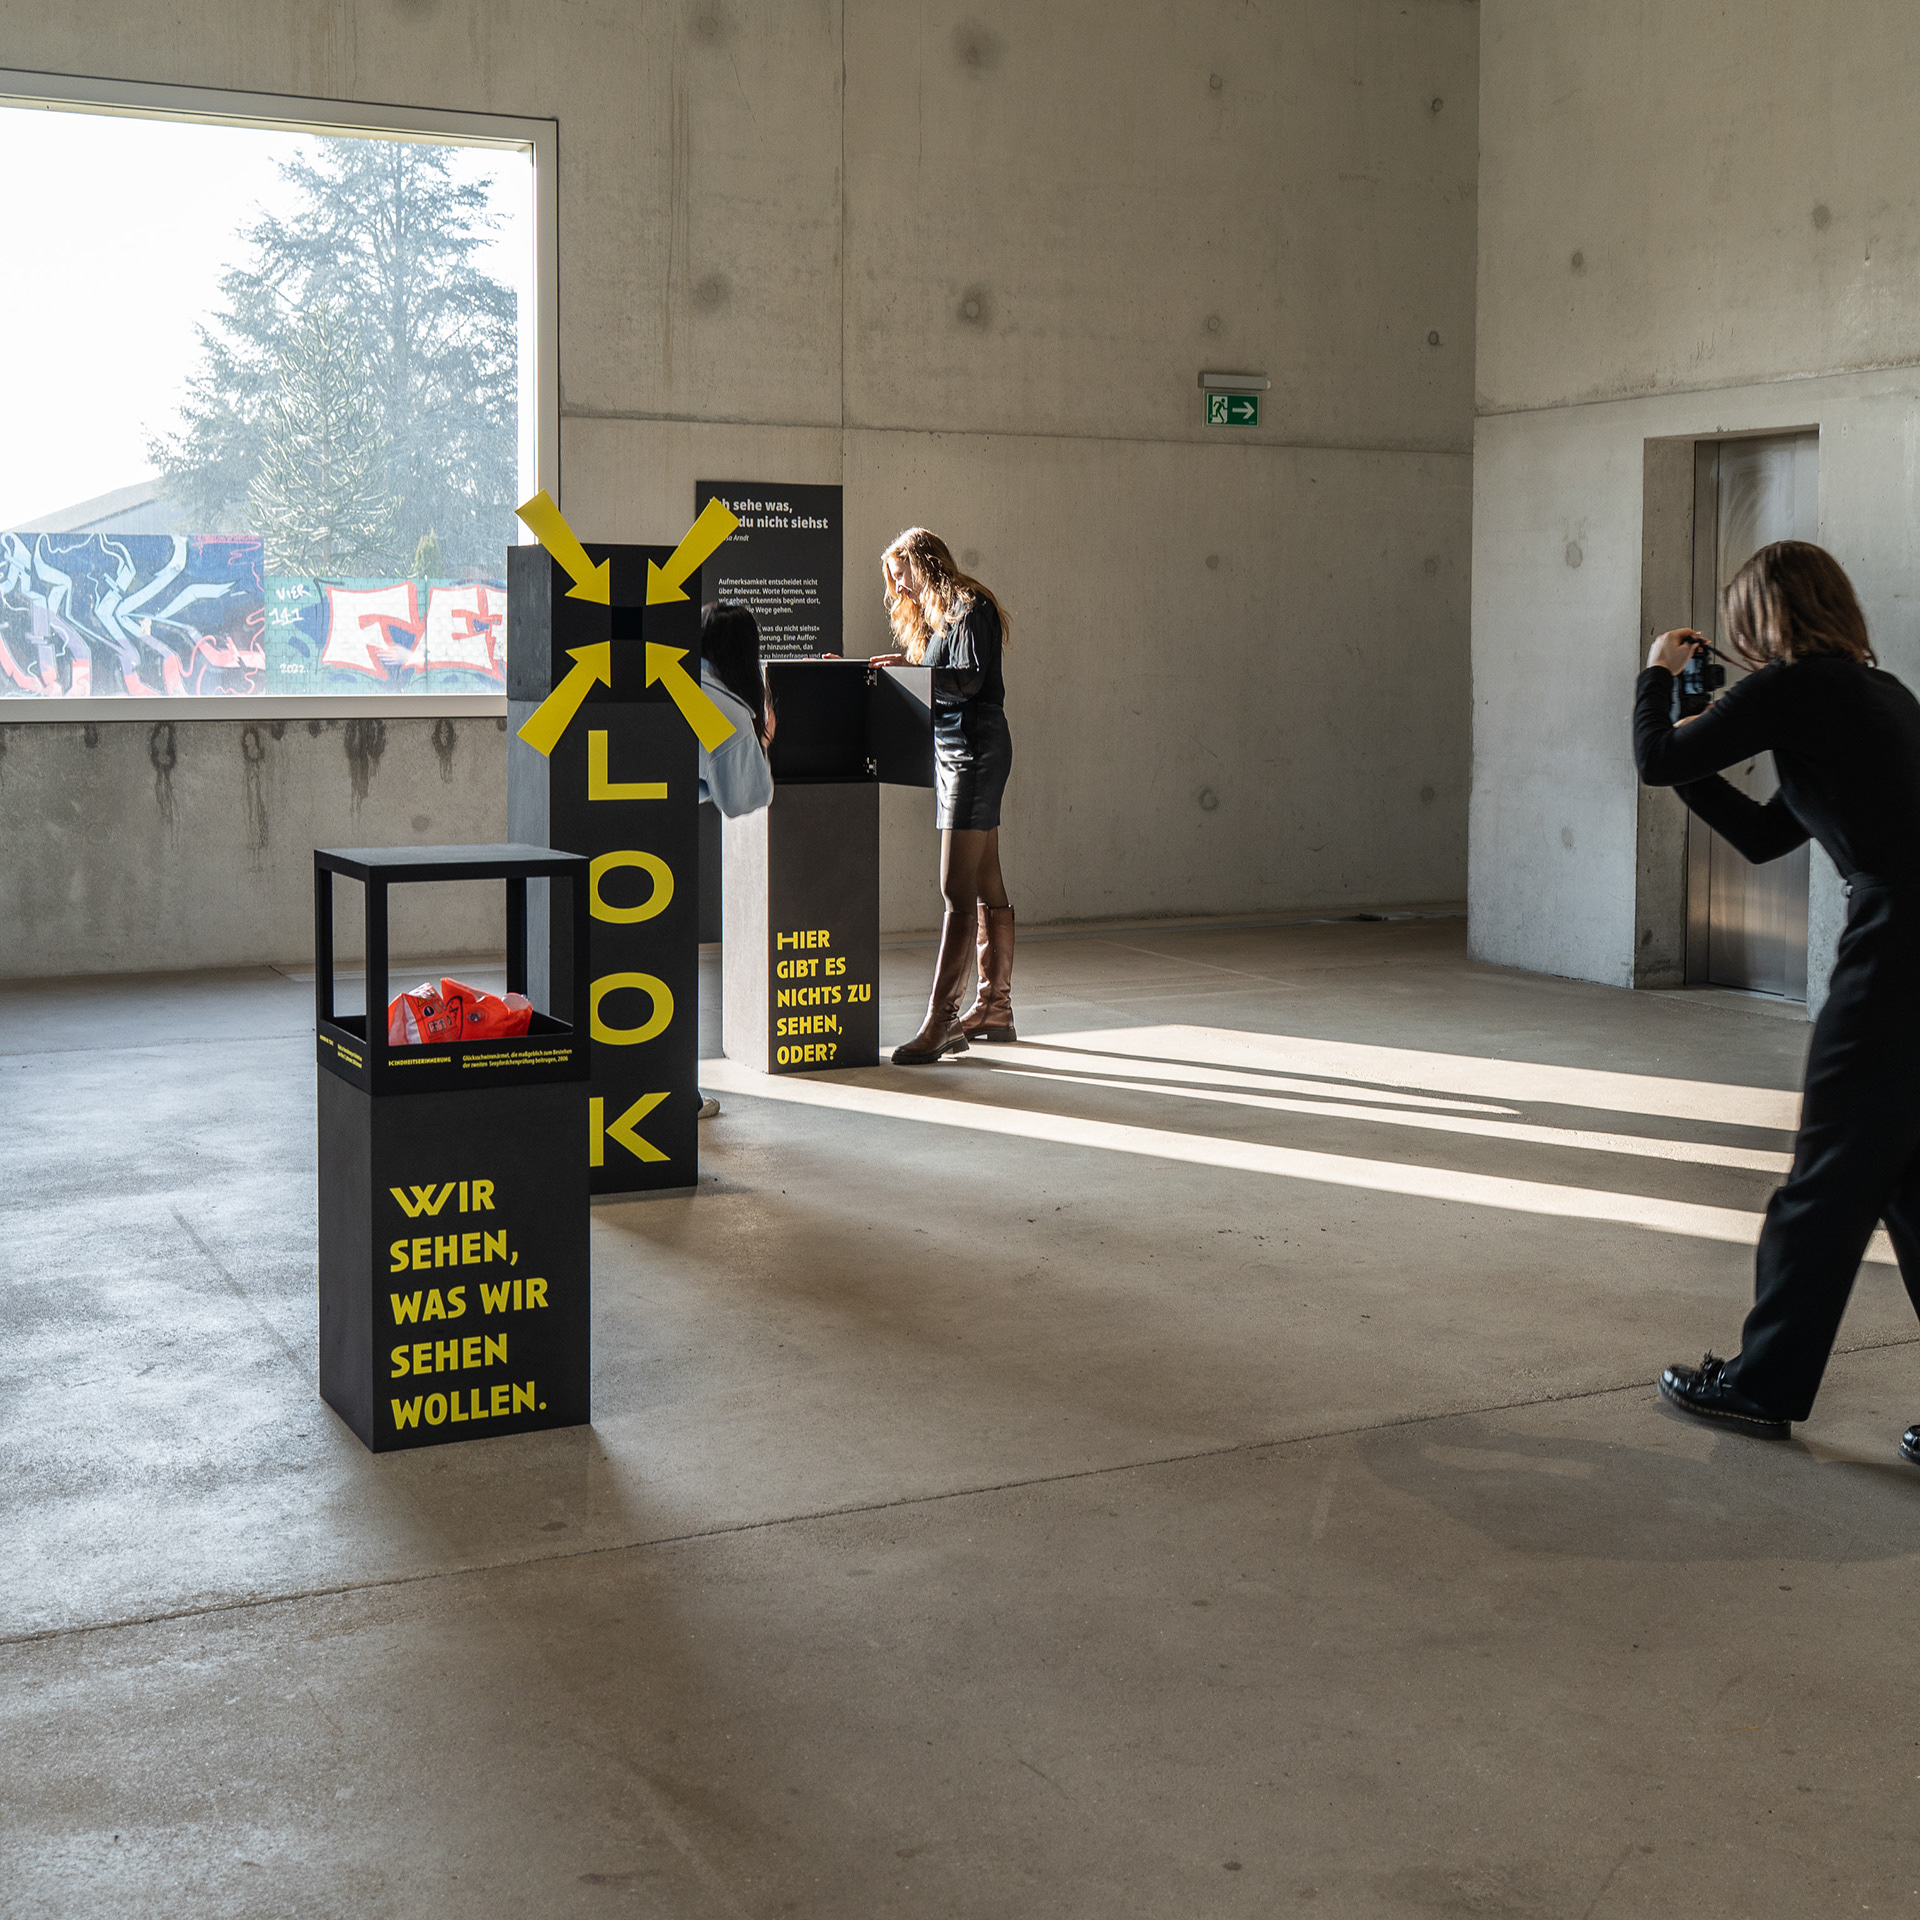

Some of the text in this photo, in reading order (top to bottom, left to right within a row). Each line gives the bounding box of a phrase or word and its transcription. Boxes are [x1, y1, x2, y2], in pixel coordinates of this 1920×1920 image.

[733, 499, 762, 511] sehe
[765, 501, 793, 514] was,
[739, 516, 829, 529] du nicht siehst
[276, 584, 311, 600] VIER
[718, 578, 767, 586] Aufmerksamkeit
[781, 587, 804, 595] formen,
[755, 606, 772, 616] Wege
[773, 606, 794, 616] gehen.
[782, 597, 805, 606] beginnt
[806, 597, 820, 605] dort,
[588, 730, 675, 1167] LOOK
[777, 930, 830, 950] HIER
[776, 957, 847, 979] GIBT ES
[777, 984, 871, 1008] NICHTS ZU
[776, 1014, 843, 1036] SEHEN,
[776, 1043, 838, 1065] ODER?
[389, 1179, 496, 1218] WIR
[390, 1229, 518, 1272] SEHEN,
[390, 1277, 549, 1325] WAS WIR
[390, 1333, 508, 1378] SEHEN
[391, 1381, 547, 1430] WOLLEN.
